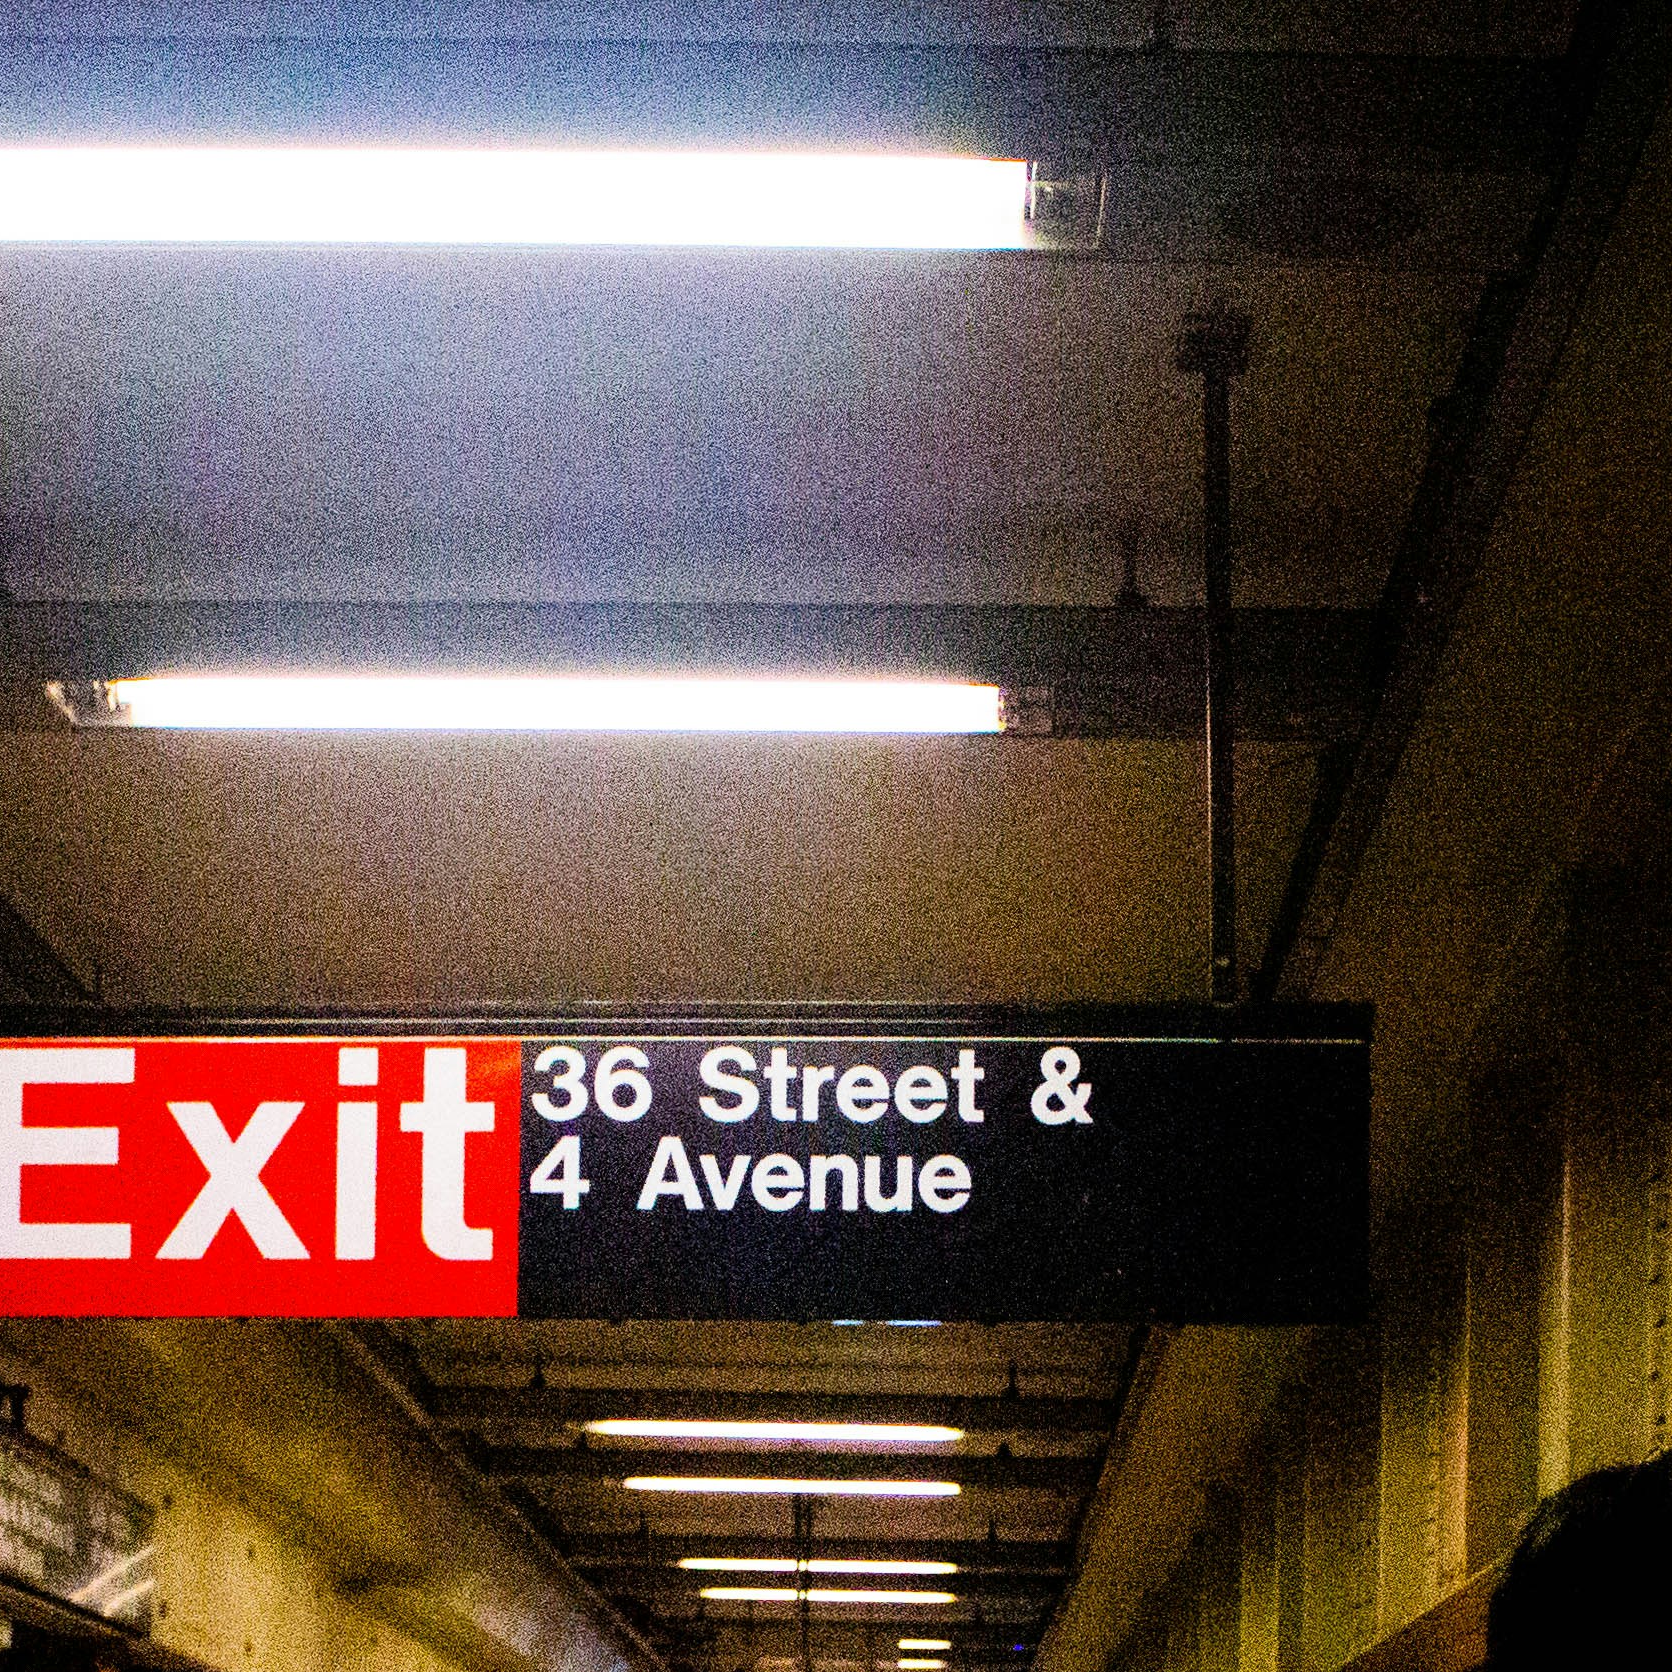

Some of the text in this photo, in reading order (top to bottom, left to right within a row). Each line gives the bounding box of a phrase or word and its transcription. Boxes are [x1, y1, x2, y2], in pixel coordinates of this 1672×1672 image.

[530, 1045, 1095, 1126] 36 Street &
[529, 1135, 973, 1212] 4 Avenue
